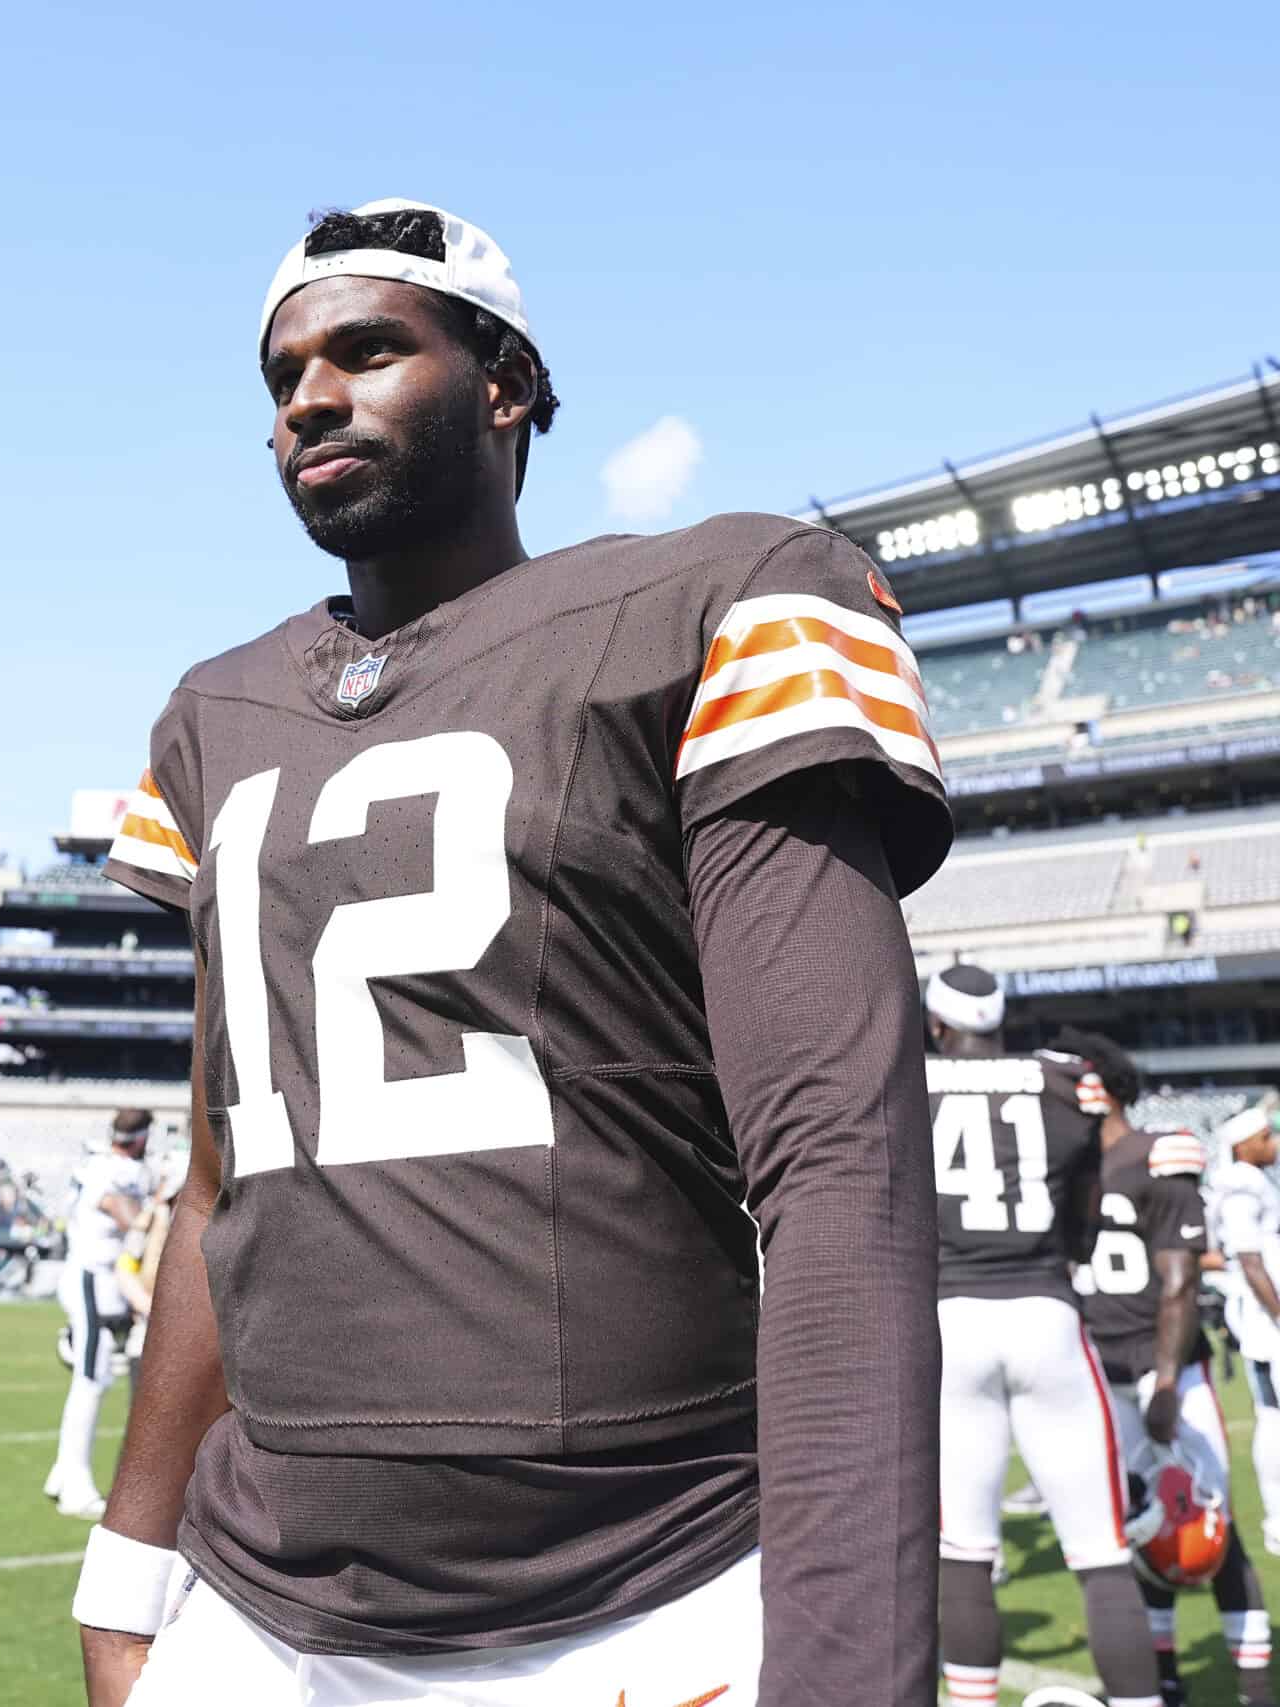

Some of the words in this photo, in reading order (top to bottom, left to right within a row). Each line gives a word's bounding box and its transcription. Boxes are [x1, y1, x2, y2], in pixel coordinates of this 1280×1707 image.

[343, 673, 371, 697] NFL
[208, 730, 556, 1179] 12
[1015, 965, 1105, 994] Lincoln
[1105, 955, 1218, 987] Financial
[932, 1094, 1054, 1233] 41
